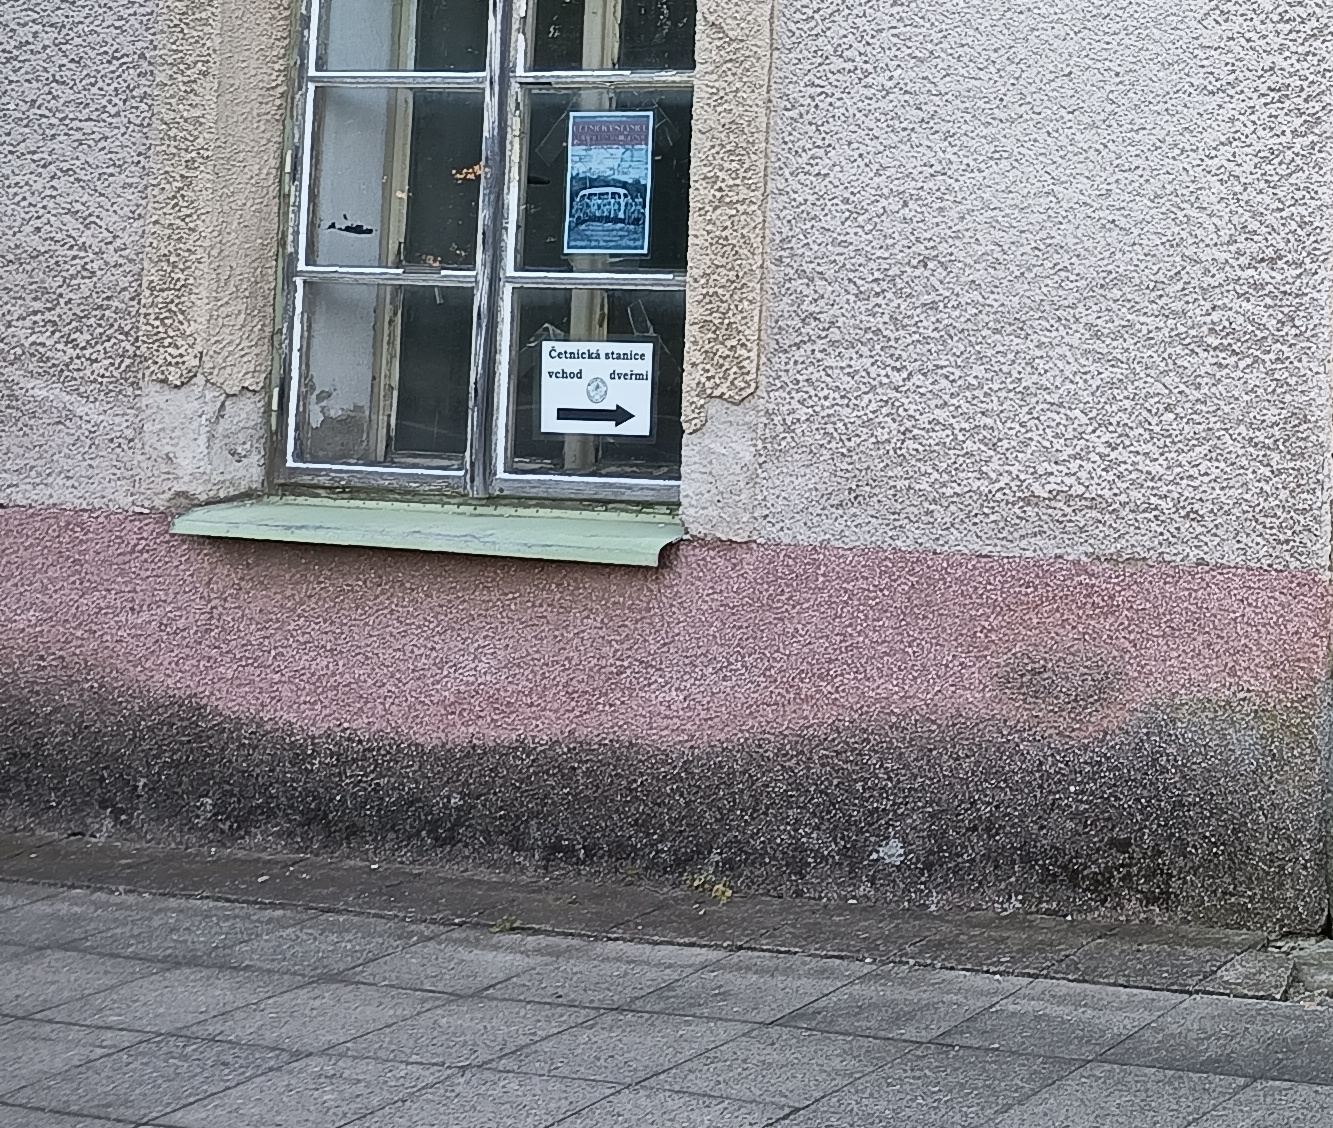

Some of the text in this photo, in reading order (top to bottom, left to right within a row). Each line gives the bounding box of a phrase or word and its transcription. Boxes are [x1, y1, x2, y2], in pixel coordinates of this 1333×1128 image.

[548, 346, 646, 361] Četnická stanice
[547, 369, 649, 381] vchod dveřmi
